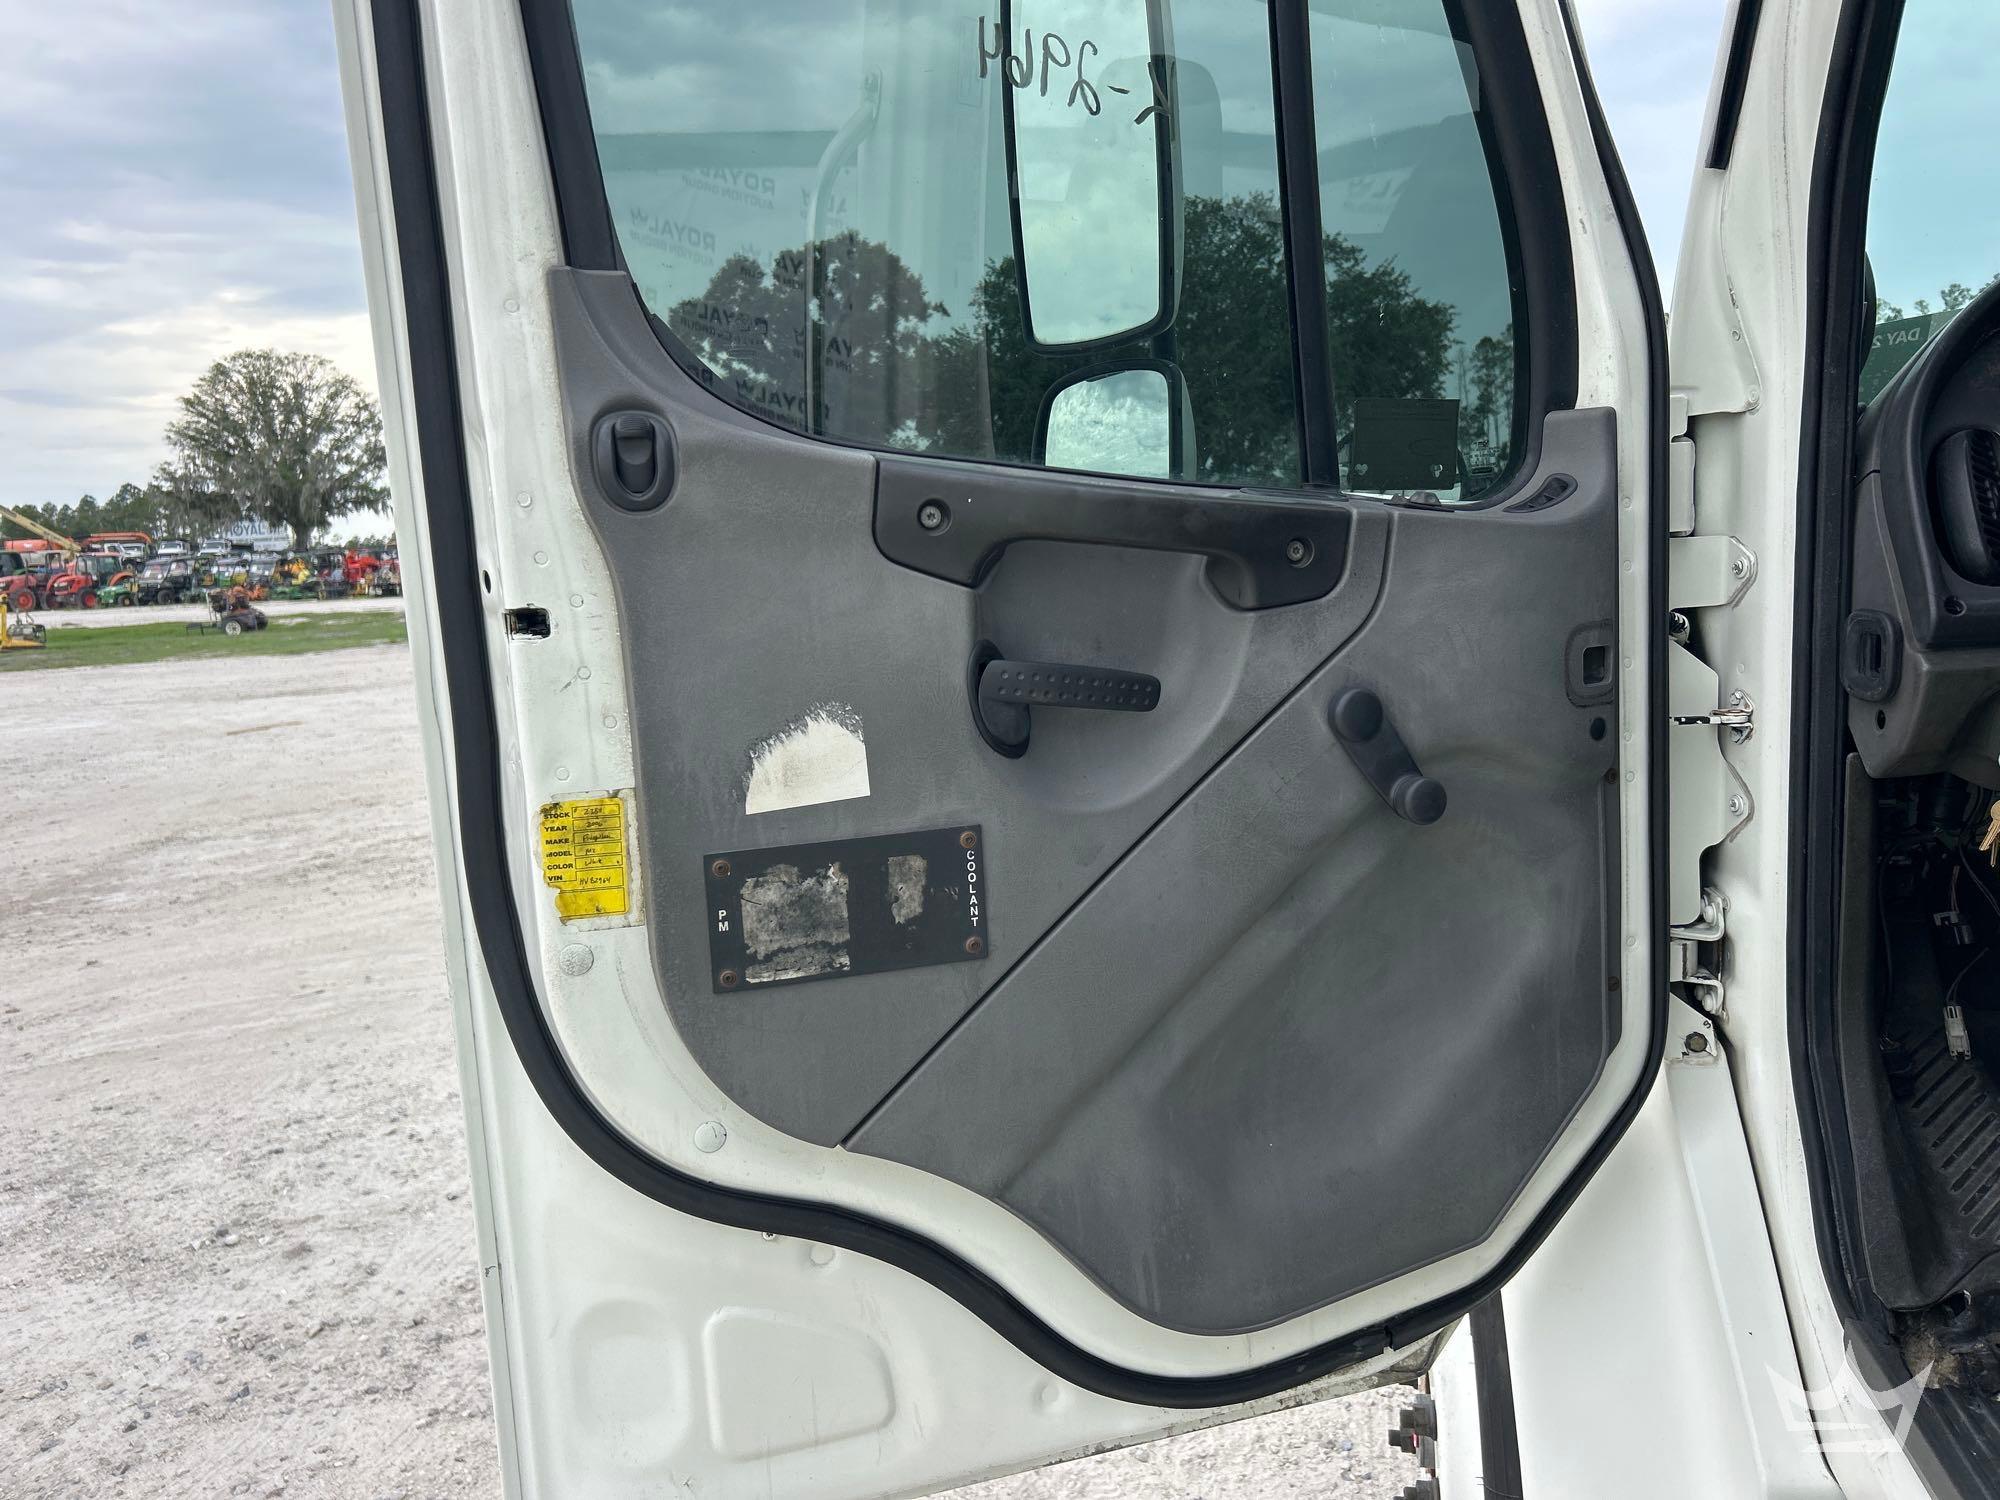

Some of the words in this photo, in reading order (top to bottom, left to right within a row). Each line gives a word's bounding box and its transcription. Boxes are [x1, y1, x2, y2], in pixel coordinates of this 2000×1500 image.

[543, 812, 571, 820] STOCK
[546, 850, 573, 858] MODEL
[965, 849, 980, 928] COOLANT
